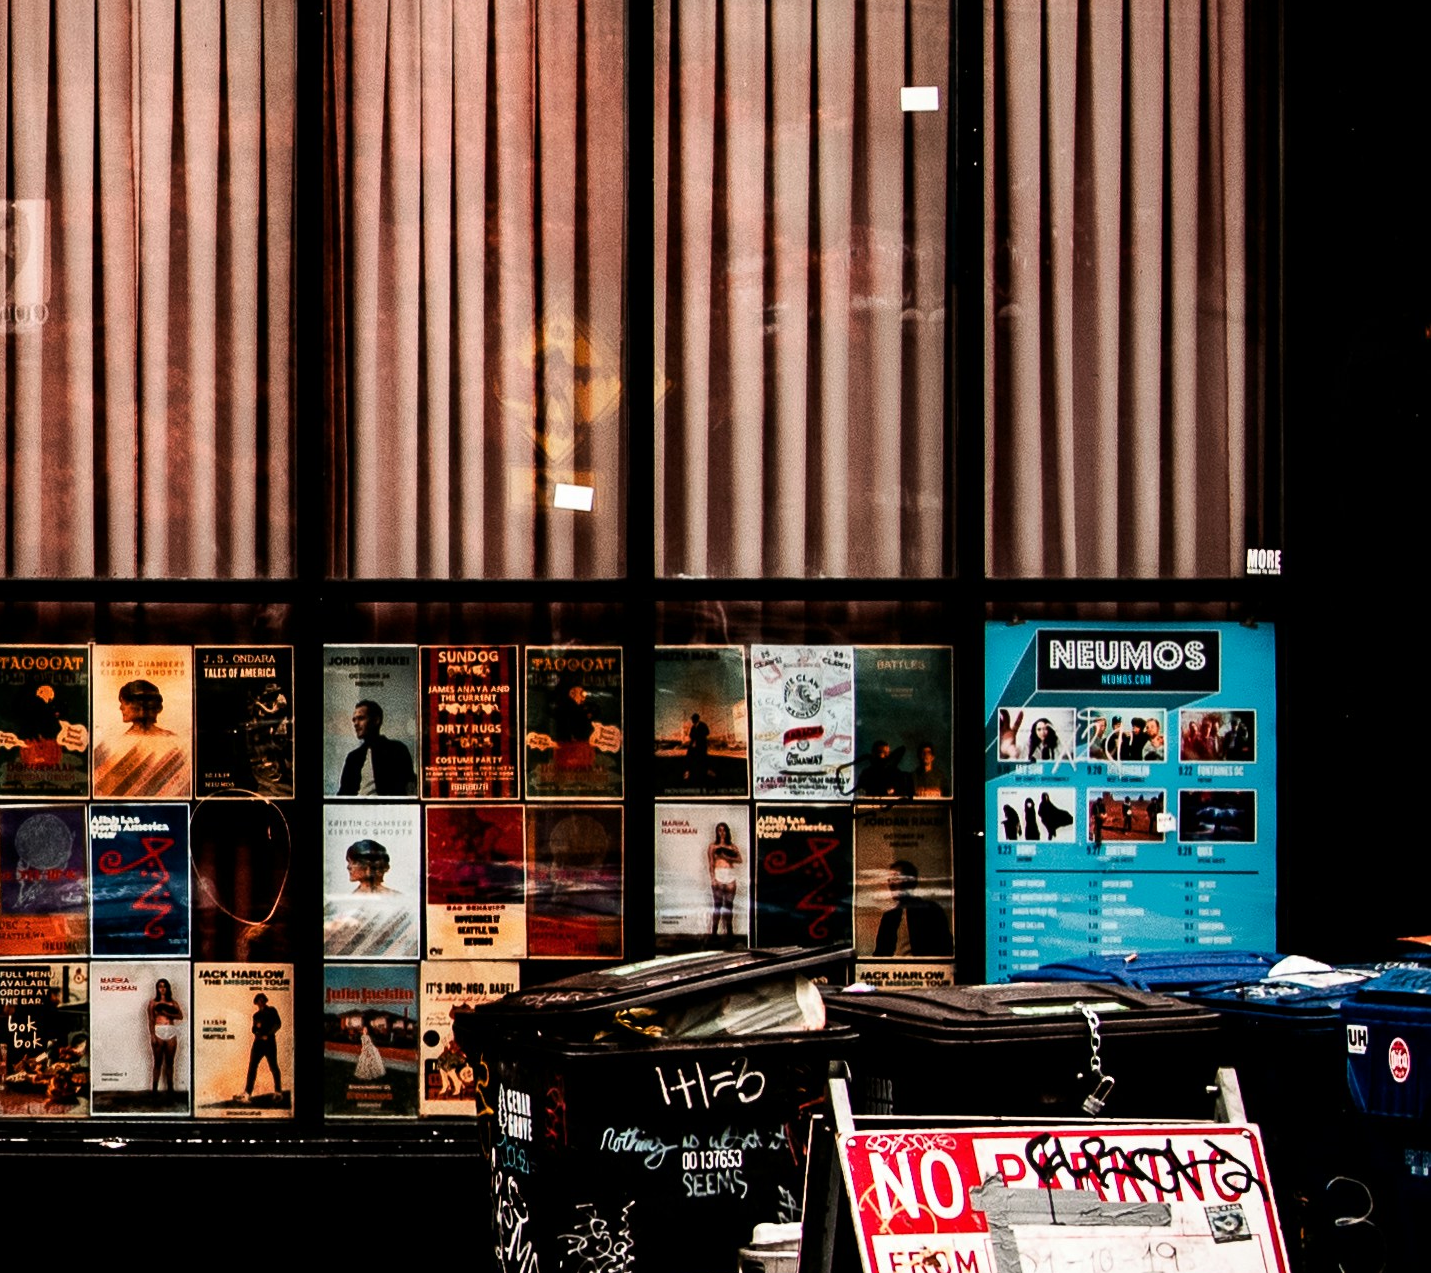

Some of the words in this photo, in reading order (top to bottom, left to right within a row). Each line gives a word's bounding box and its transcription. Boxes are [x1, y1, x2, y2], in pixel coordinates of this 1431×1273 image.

[1246, 548, 1282, 571] MORE
[232, 654, 277, 664] ONDARA
[328, 656, 374, 667] JORDAN
[438, 650, 499, 664] SUNDOG
[1048, 639, 1207, 673] NEUMOS
[204, 667, 227, 679] TALES
[228, 667, 238, 678] OF
[240, 667, 277, 678] AMERICA
[1101, 674, 1152, 686] NEUMOS.COM
[428, 685, 456, 695] JAMES
[490, 685, 510, 694] AND
[440, 694, 455, 703] THE
[456, 694, 497, 703] CURRENT
[436, 723, 469, 735] DIRTY
[471, 723, 502, 734] RUGS
[475, 756, 503, 764] PARTY
[660, 828, 698, 836] HACKMAN
[0, 970, 24, 979] FULL
[26, 970, 55, 979] MENU
[198, 969, 228, 979] JACK
[231, 969, 285, 980] HARLOW
[860, 970, 888, 981] JACK
[891, 970, 945, 981] HARLOW
[0, 989, 34, 997] ORDER
[36, 989, 49, 997] AT
[425, 981, 443, 994] IT'S
[0, 998, 18, 1006] THE
[21, 998, 45, 1006] BAR.
[7, 1015, 38, 1034] bok
[13, 1032, 44, 1050] bok
[1348, 1029, 1368, 1048] UH
[600, 1126, 678, 1170] Nothing
[682, 1170, 749, 1200] SEEMS
[868, 1148, 966, 1220] NO
